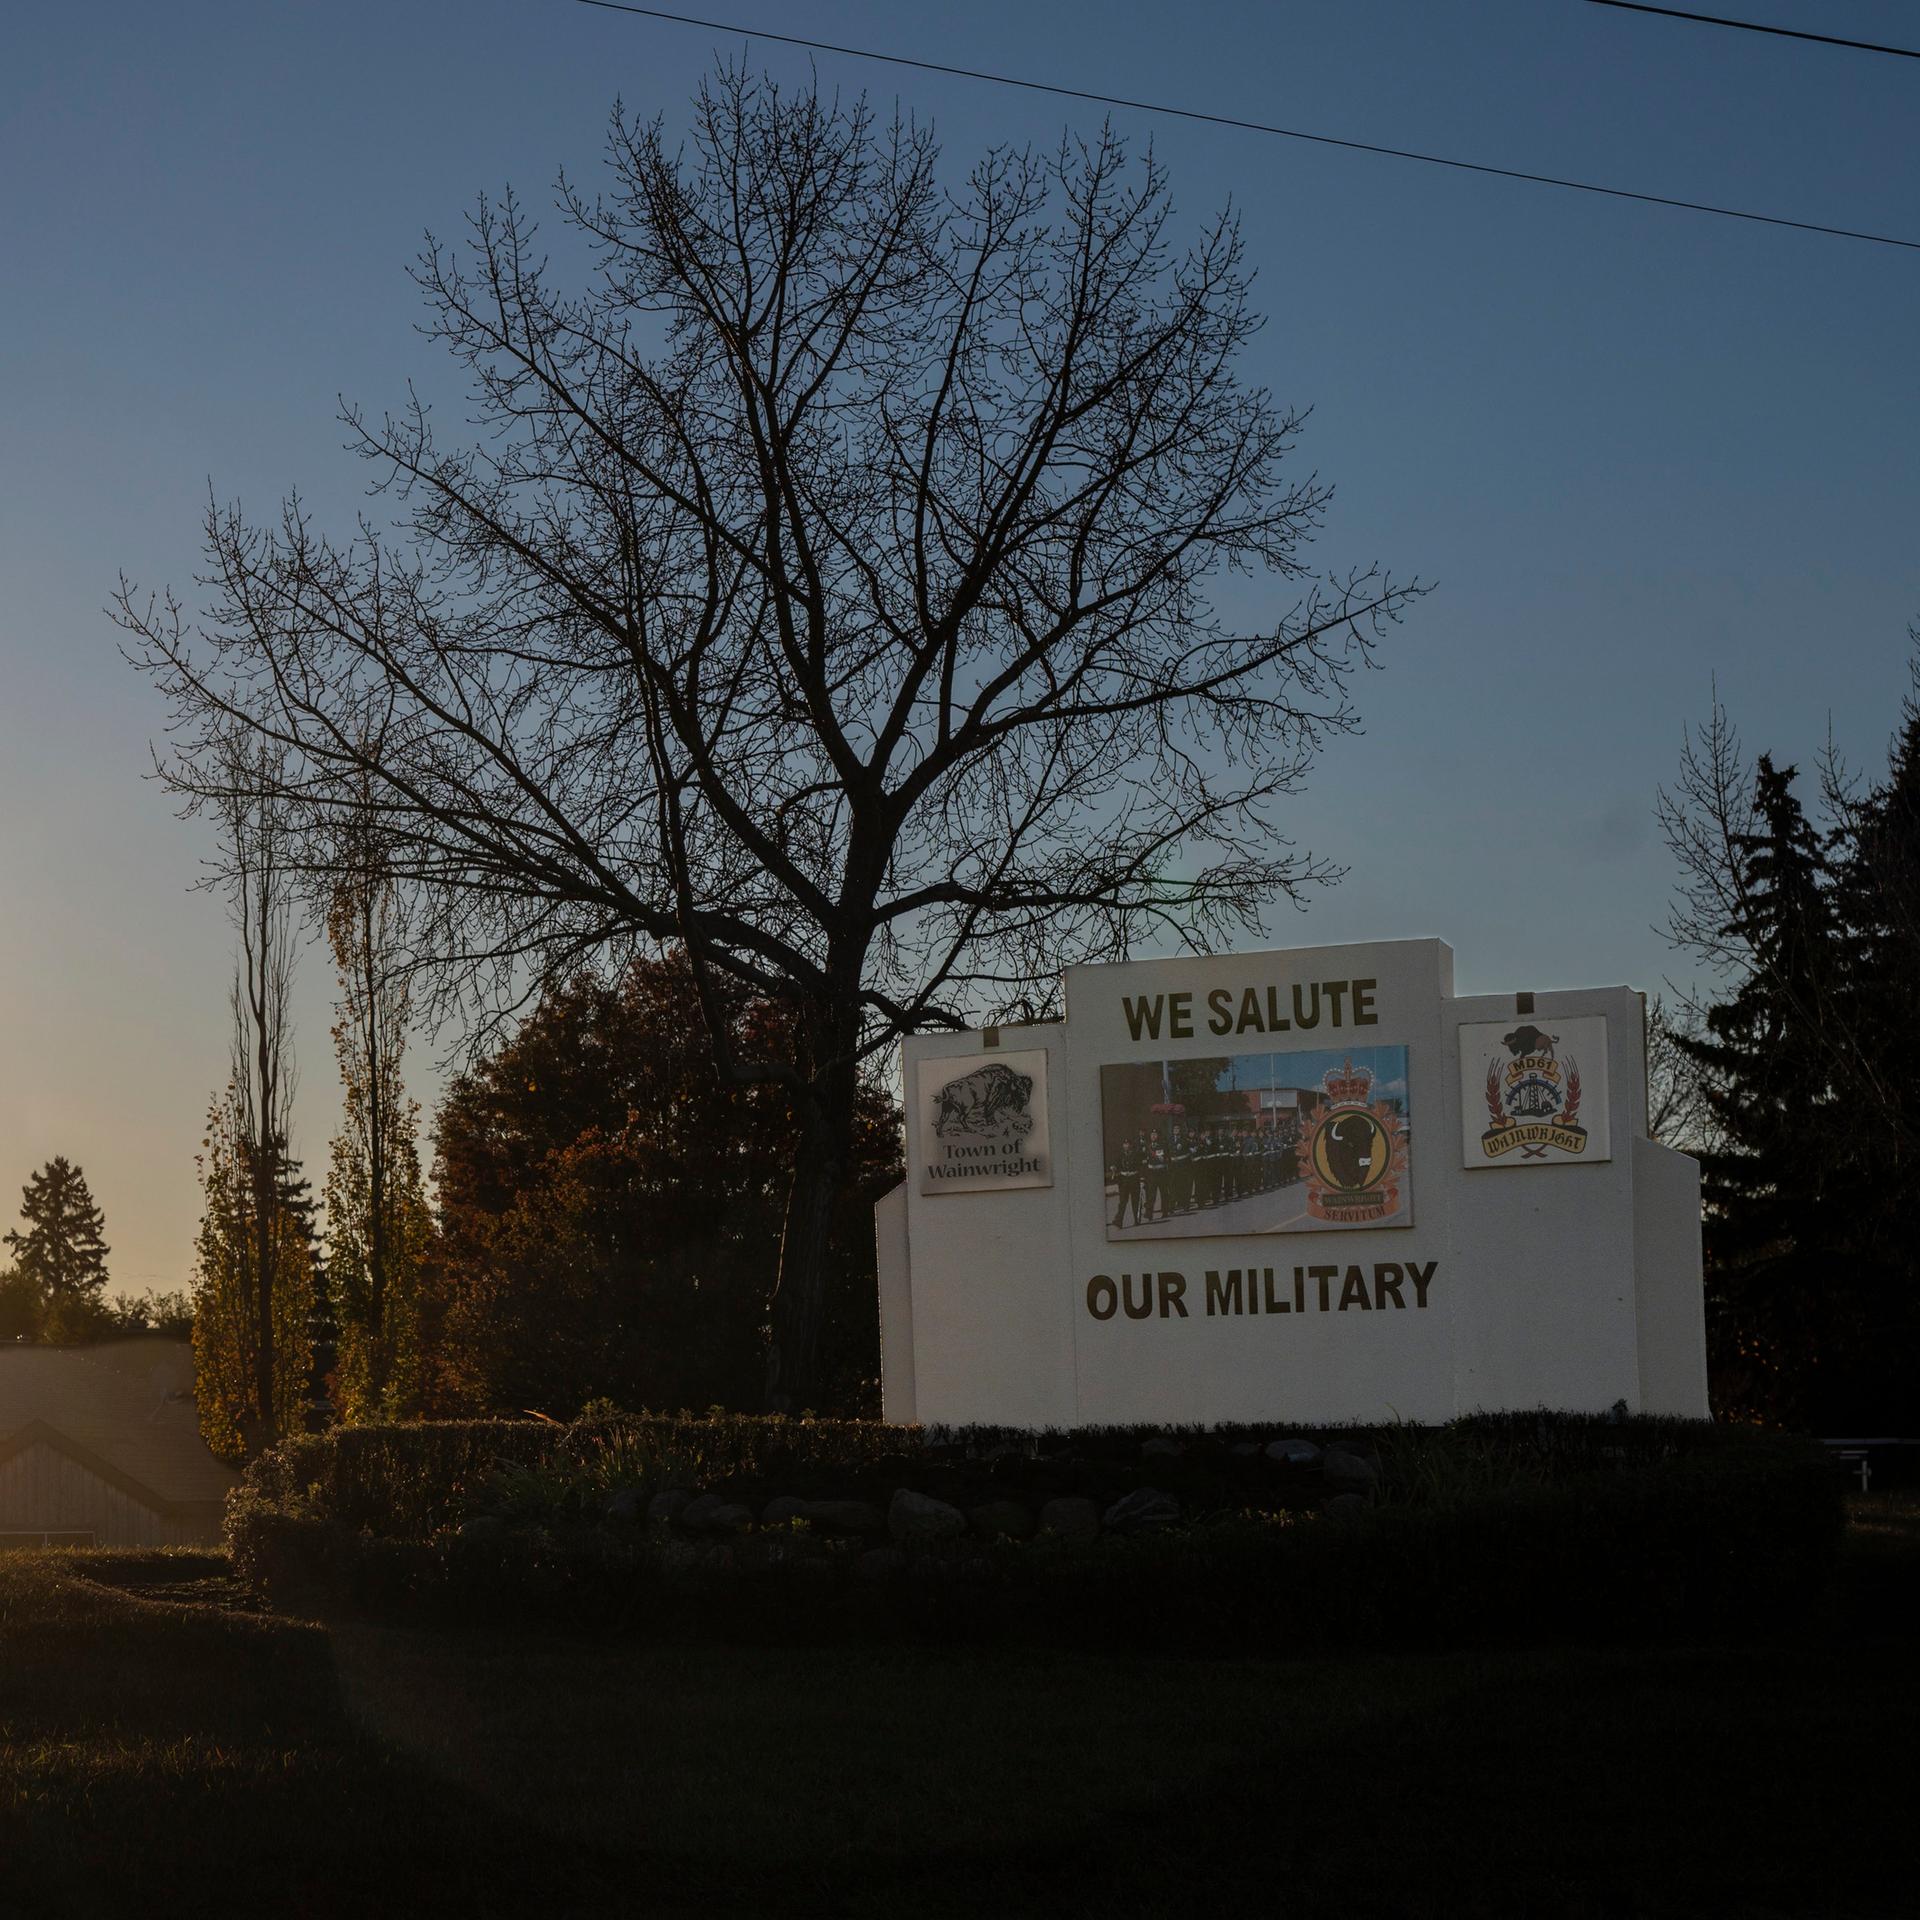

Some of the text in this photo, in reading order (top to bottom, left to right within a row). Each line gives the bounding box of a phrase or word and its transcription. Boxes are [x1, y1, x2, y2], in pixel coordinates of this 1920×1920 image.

[1122, 978, 1379, 1042] WE SALUTE
[1513, 1058, 1552, 1072] MD61
[943, 1138, 1023, 1159] Town of
[928, 1157, 1041, 1179] Wainwright
[1324, 1206, 1385, 1222] SERVITUM
[1086, 1261, 1439, 1321] OUR MILITARY
